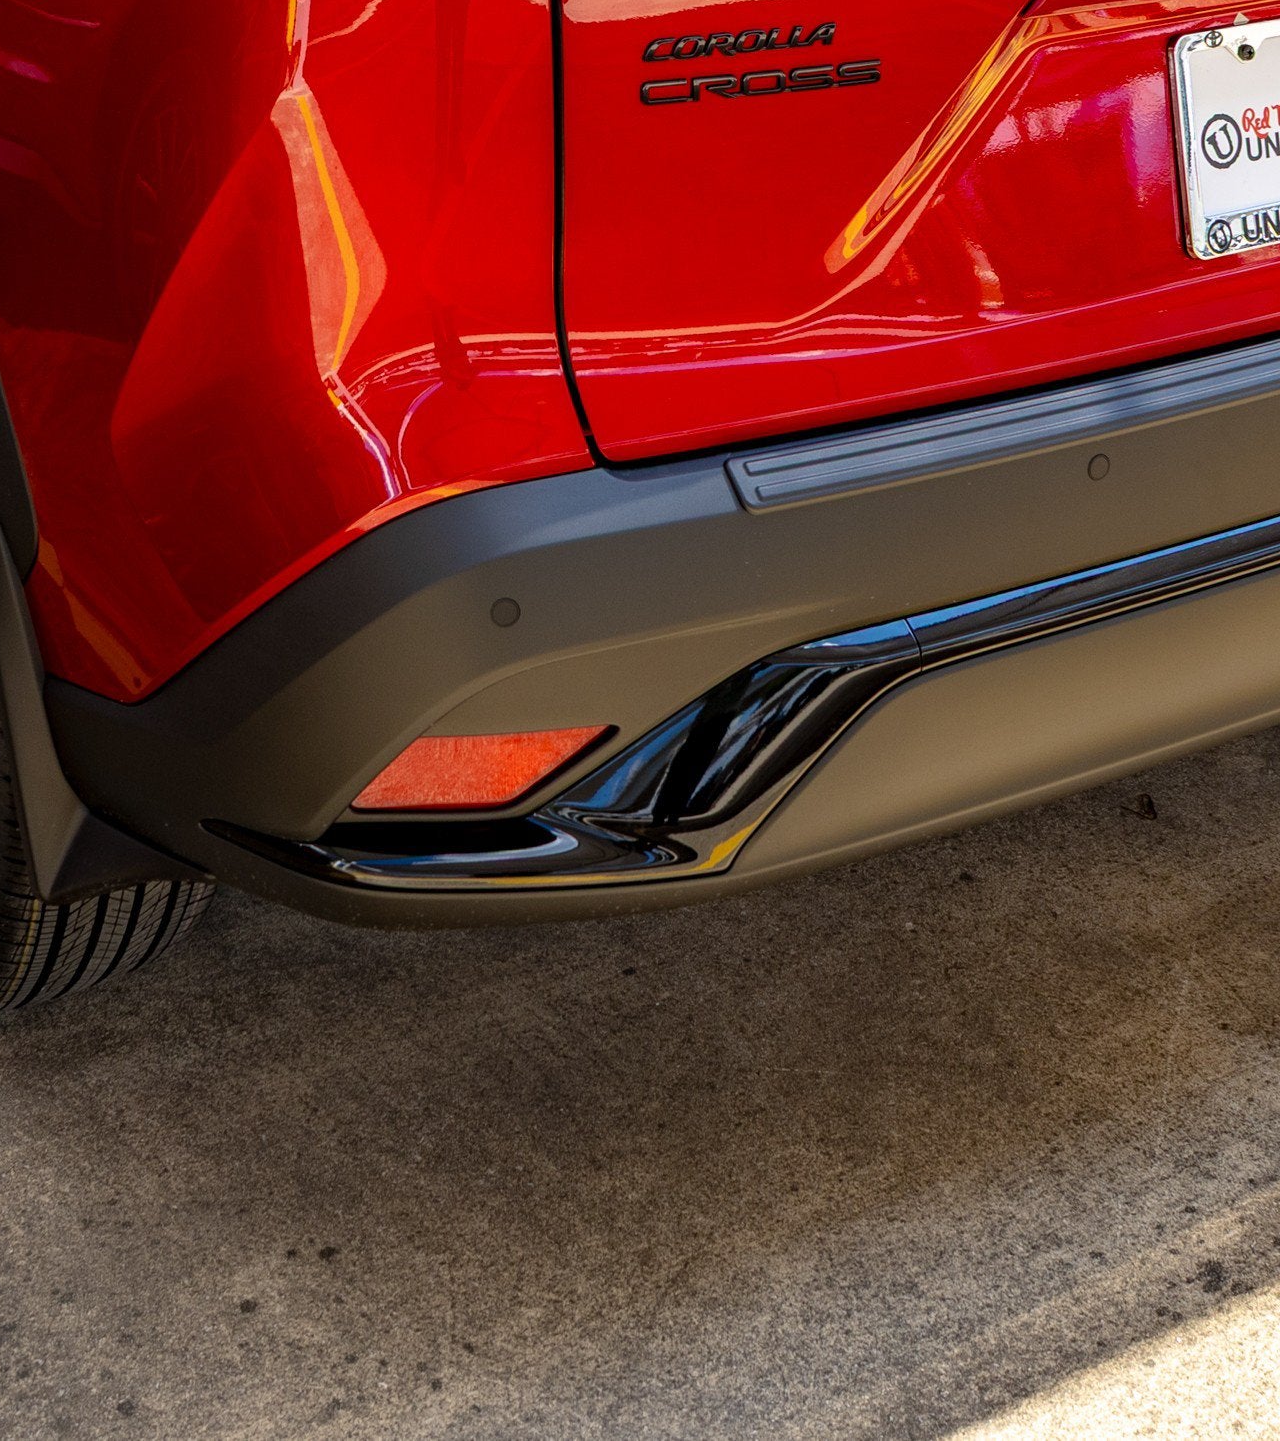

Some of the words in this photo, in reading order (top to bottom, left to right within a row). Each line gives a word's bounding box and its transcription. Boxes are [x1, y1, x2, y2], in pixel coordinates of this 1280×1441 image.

[642, 22, 836, 62] COROLLA
[640, 59, 881, 105] CROSS
[1242, 107, 1271, 139] Red
